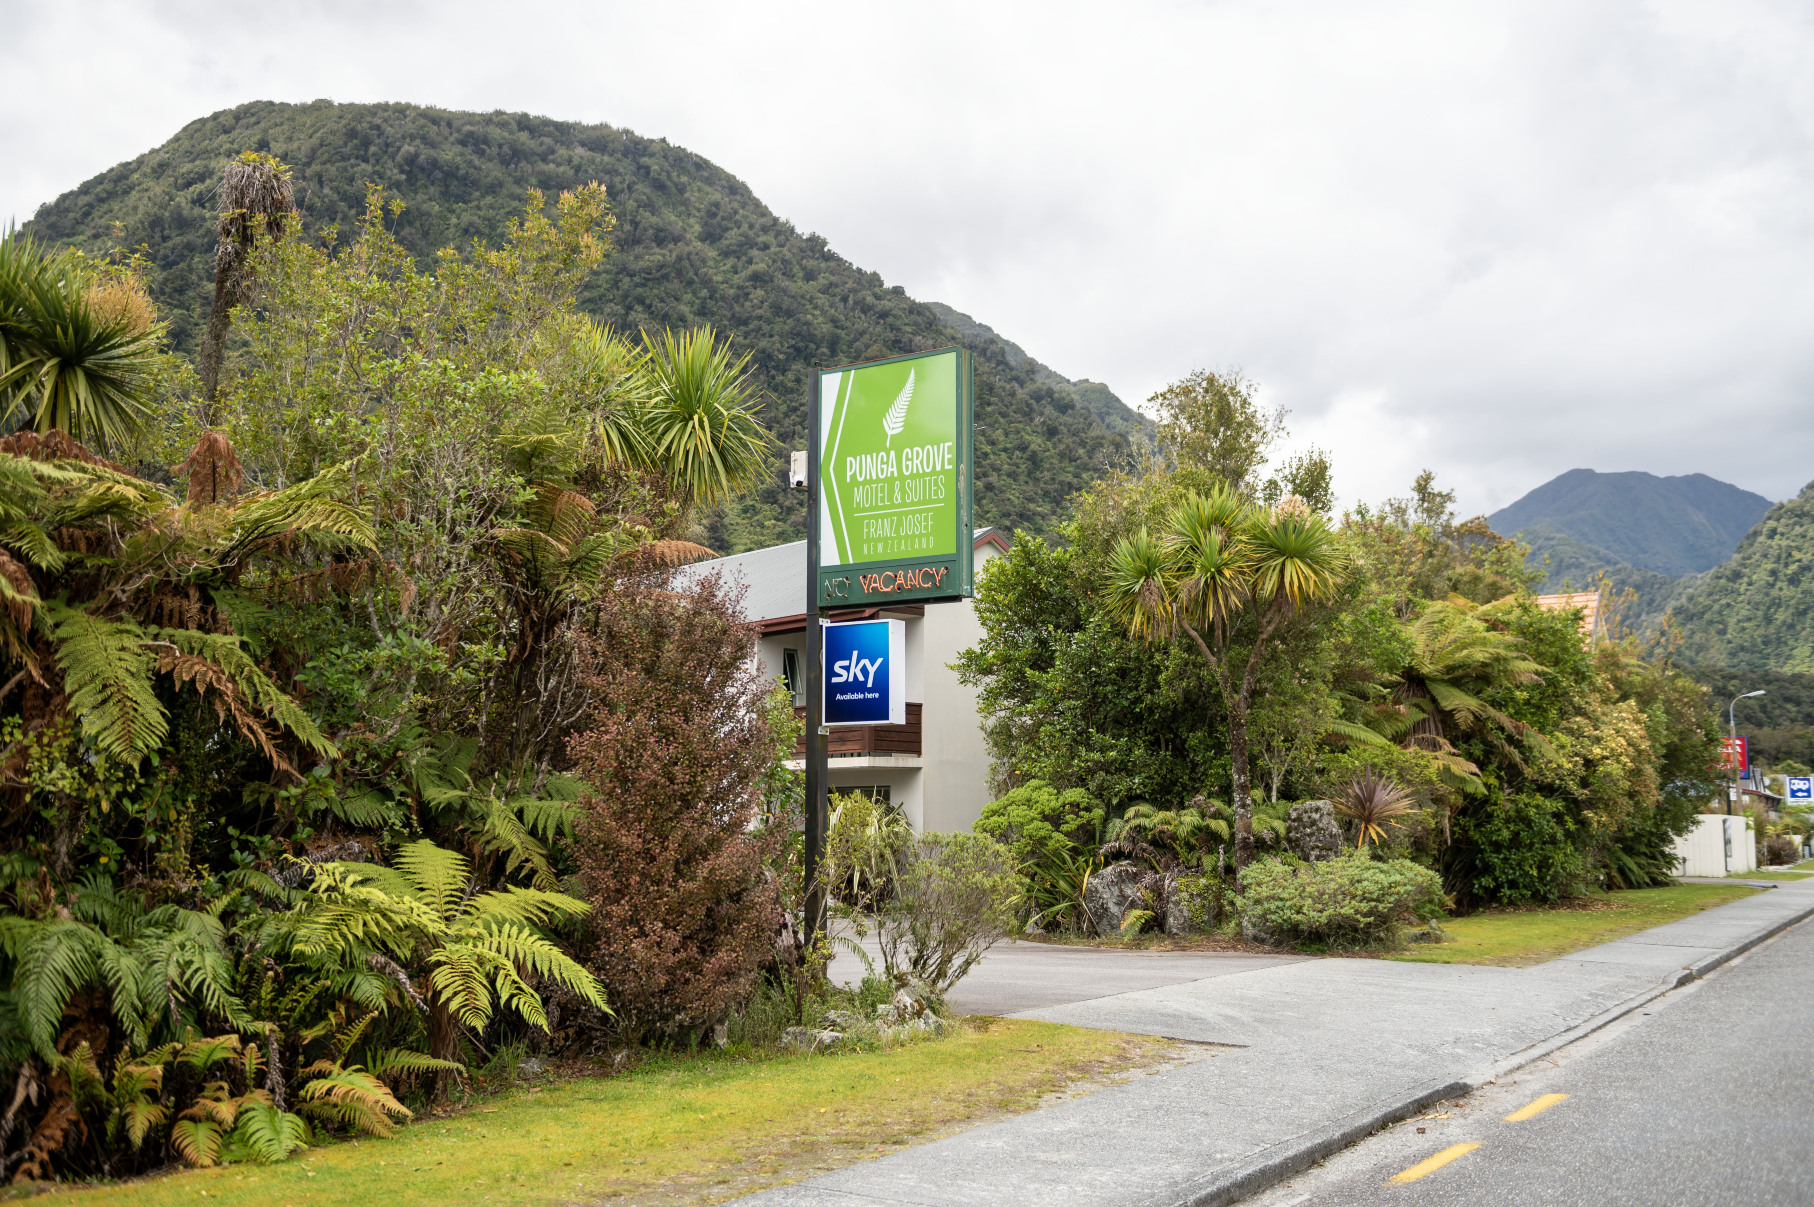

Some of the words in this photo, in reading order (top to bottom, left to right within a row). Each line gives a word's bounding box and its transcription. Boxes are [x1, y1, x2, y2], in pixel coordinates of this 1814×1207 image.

[846, 450, 897, 483] PUNGA
[902, 442, 953, 476] GROVE
[853, 483, 891, 509] MOTEL
[893, 481, 902, 504] &
[905, 475, 945, 503] SUITES
[863, 517, 897, 539] FRANZ
[900, 512, 934, 536] JOSEF
[863, 542, 884, 555] NEW
[887, 536, 934, 553] ZEALAND
[860, 567, 945, 593] VACANCY
[831, 650, 884, 688] sky
[835, 691, 864, 701] Available
[865, 691, 879, 699] here
